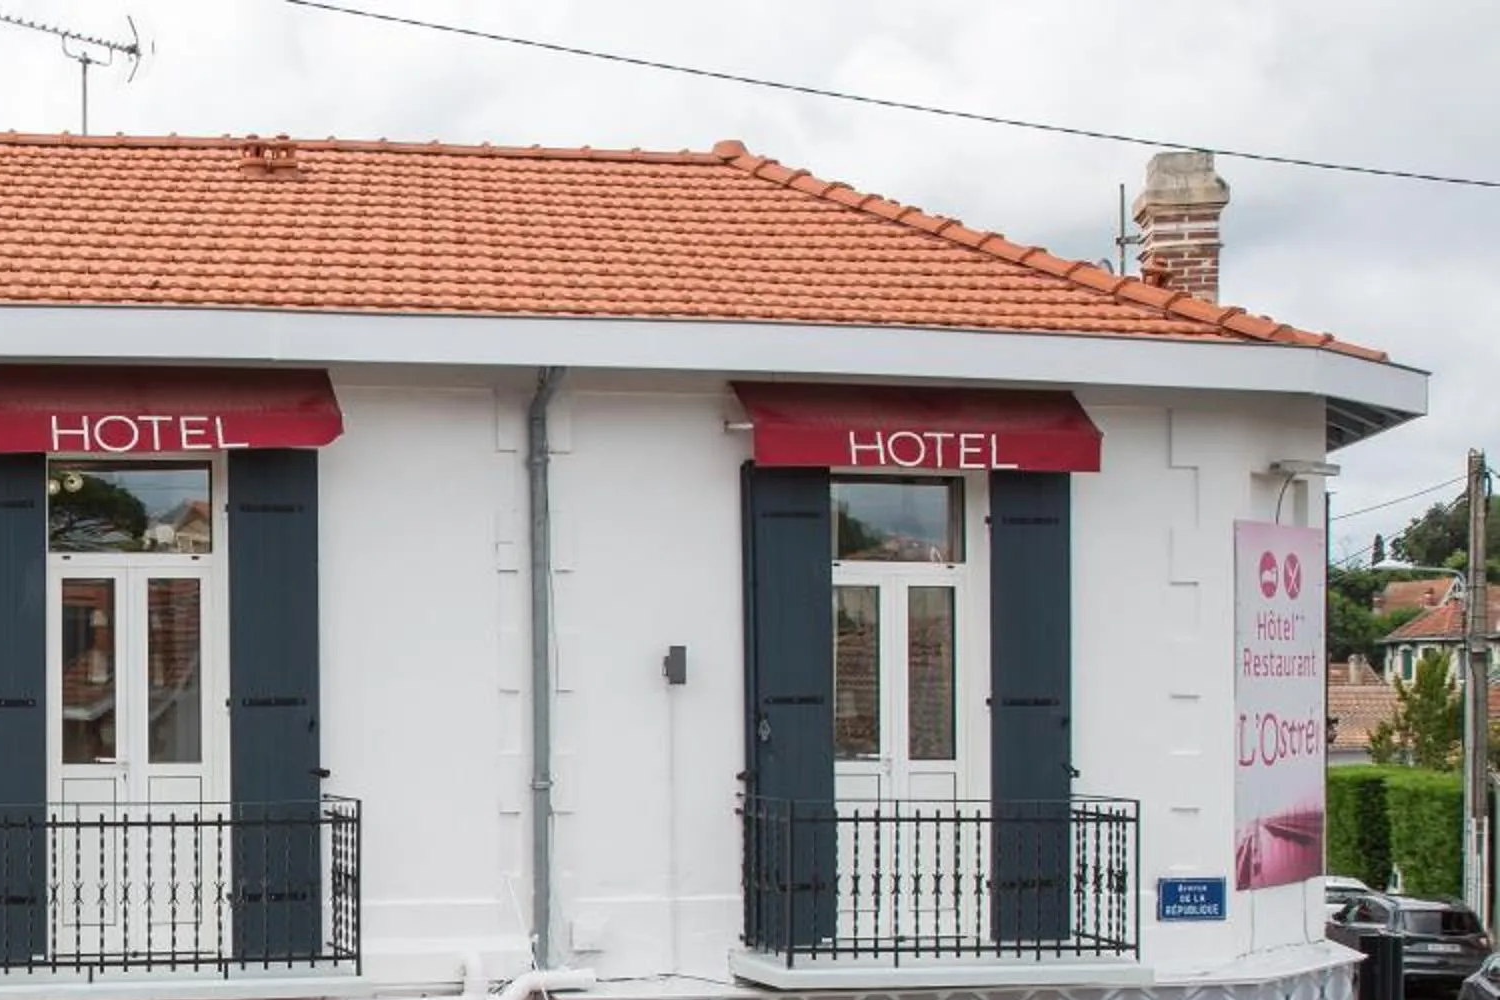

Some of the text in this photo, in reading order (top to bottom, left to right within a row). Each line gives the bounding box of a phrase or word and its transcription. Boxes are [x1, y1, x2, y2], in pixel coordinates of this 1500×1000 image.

[51, 415, 250, 452] HOTEL
[849, 431, 1019, 469] HOTEL
[1243, 648, 1316, 677] Restaurant
